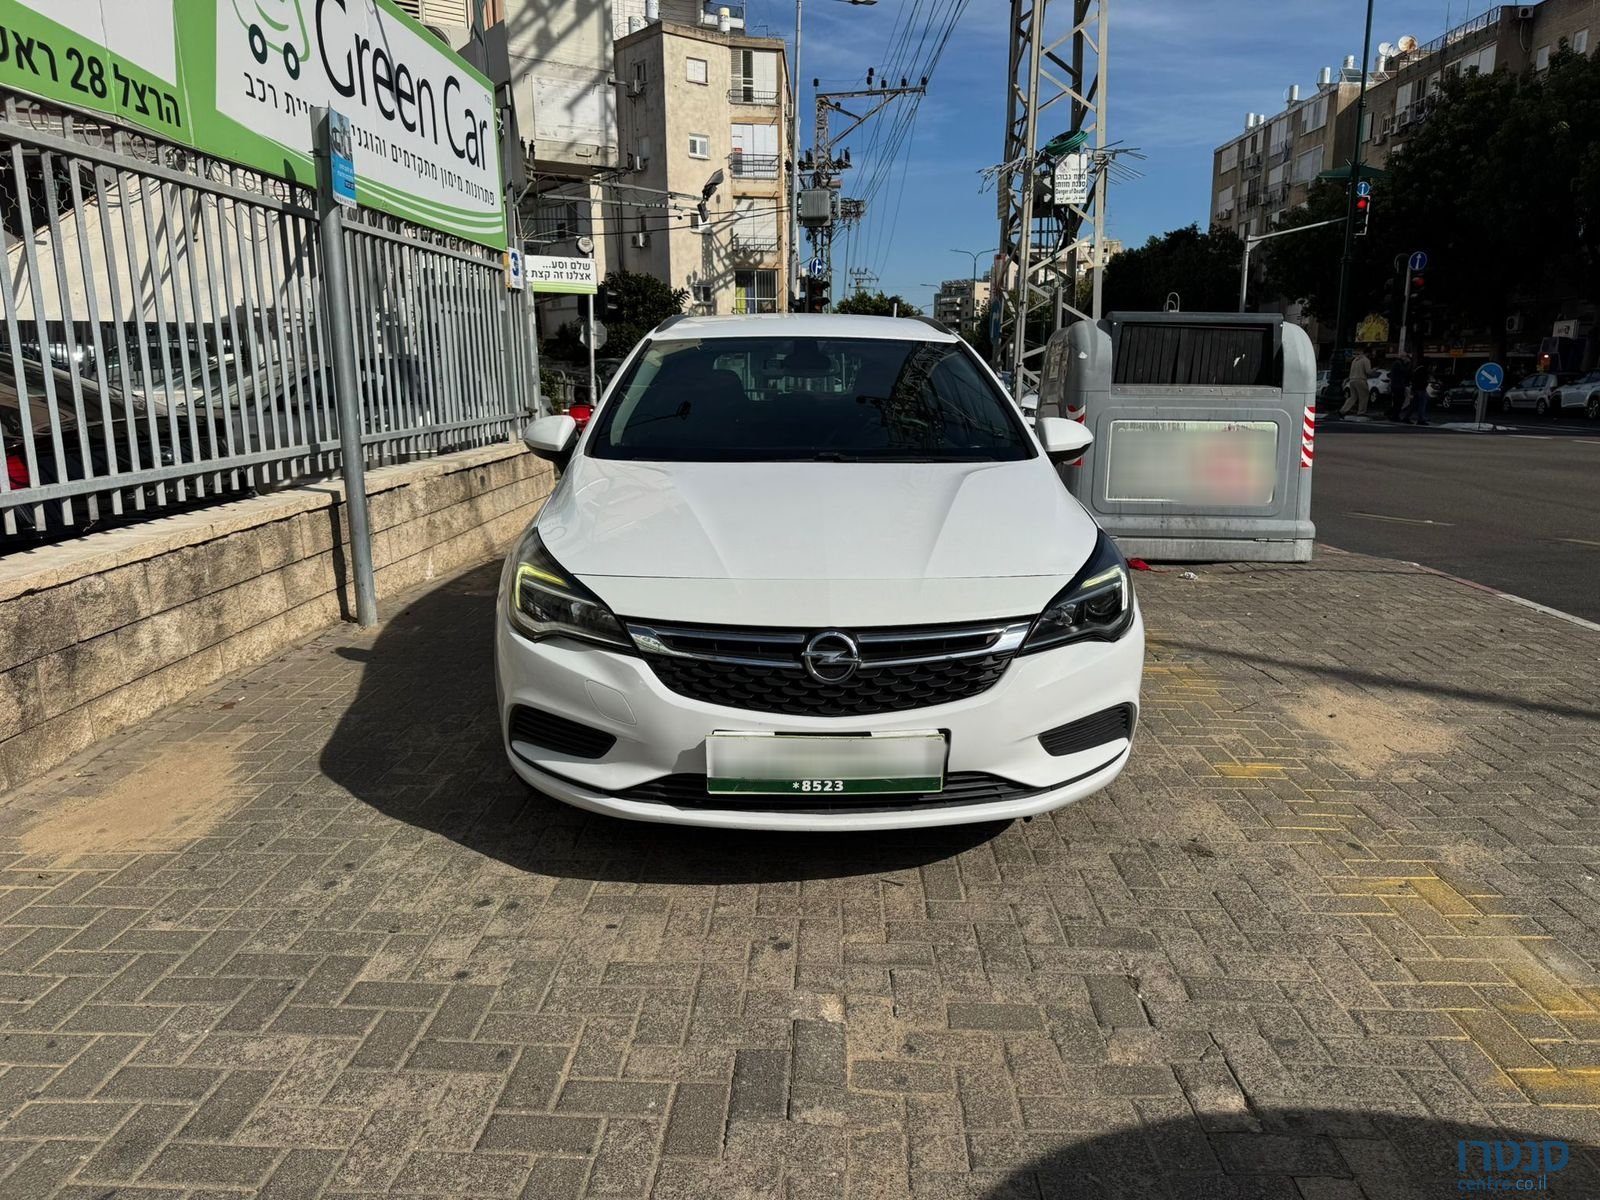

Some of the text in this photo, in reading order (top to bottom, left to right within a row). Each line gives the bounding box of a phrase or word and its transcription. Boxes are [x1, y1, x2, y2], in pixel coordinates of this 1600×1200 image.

[66, 47, 107, 99] 28
[315, 0, 487, 170] Green Car
[112, 63, 181, 127] הרצל
[244, 72, 278, 109] רכב
[351, 124, 387, 158] והוגני
[391, 144, 438, 179] מתקדמים
[440, 167, 463, 189] מימון
[465, 179, 495, 206] פתרונות
[531, 270, 551, 281] קצת
[553, 271, 564, 279] זה
[565, 270, 592, 281] אצלנו
[570, 260, 591, 271] שלם
